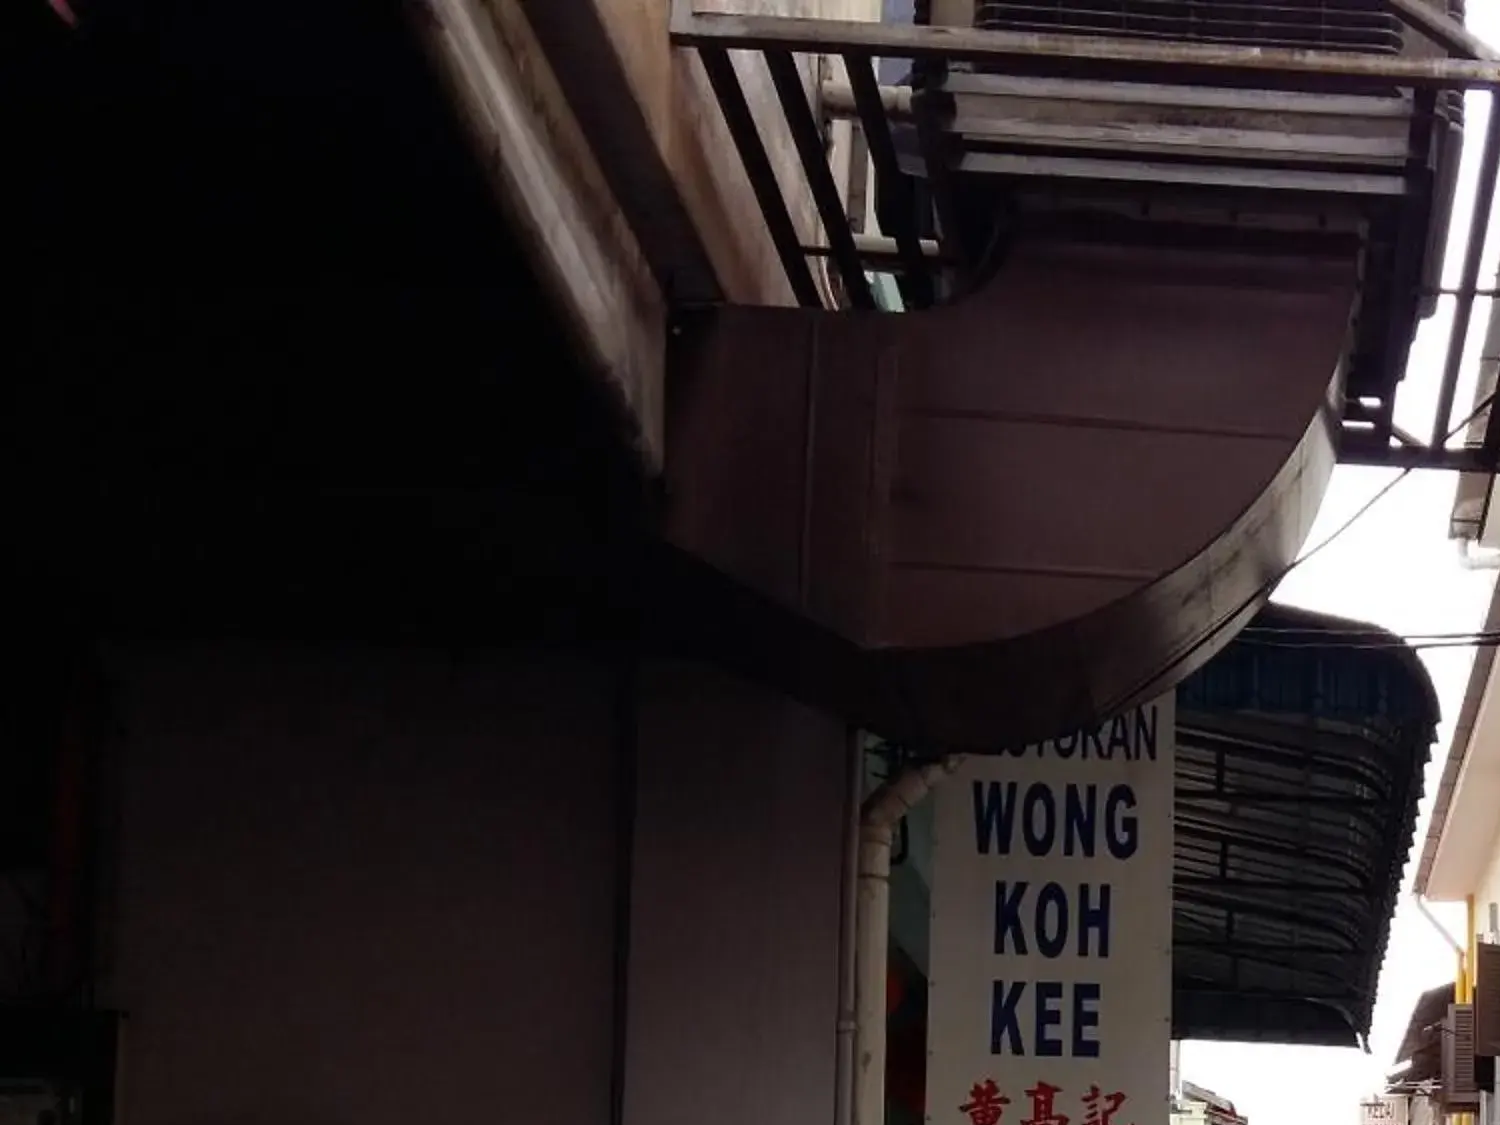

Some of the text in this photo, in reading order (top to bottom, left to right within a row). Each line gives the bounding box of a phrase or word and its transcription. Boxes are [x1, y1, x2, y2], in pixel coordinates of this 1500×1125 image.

[972, 780, 1139, 861] WONG
[993, 881, 1111, 959] KOH
[990, 980, 1101, 1057] KEE
